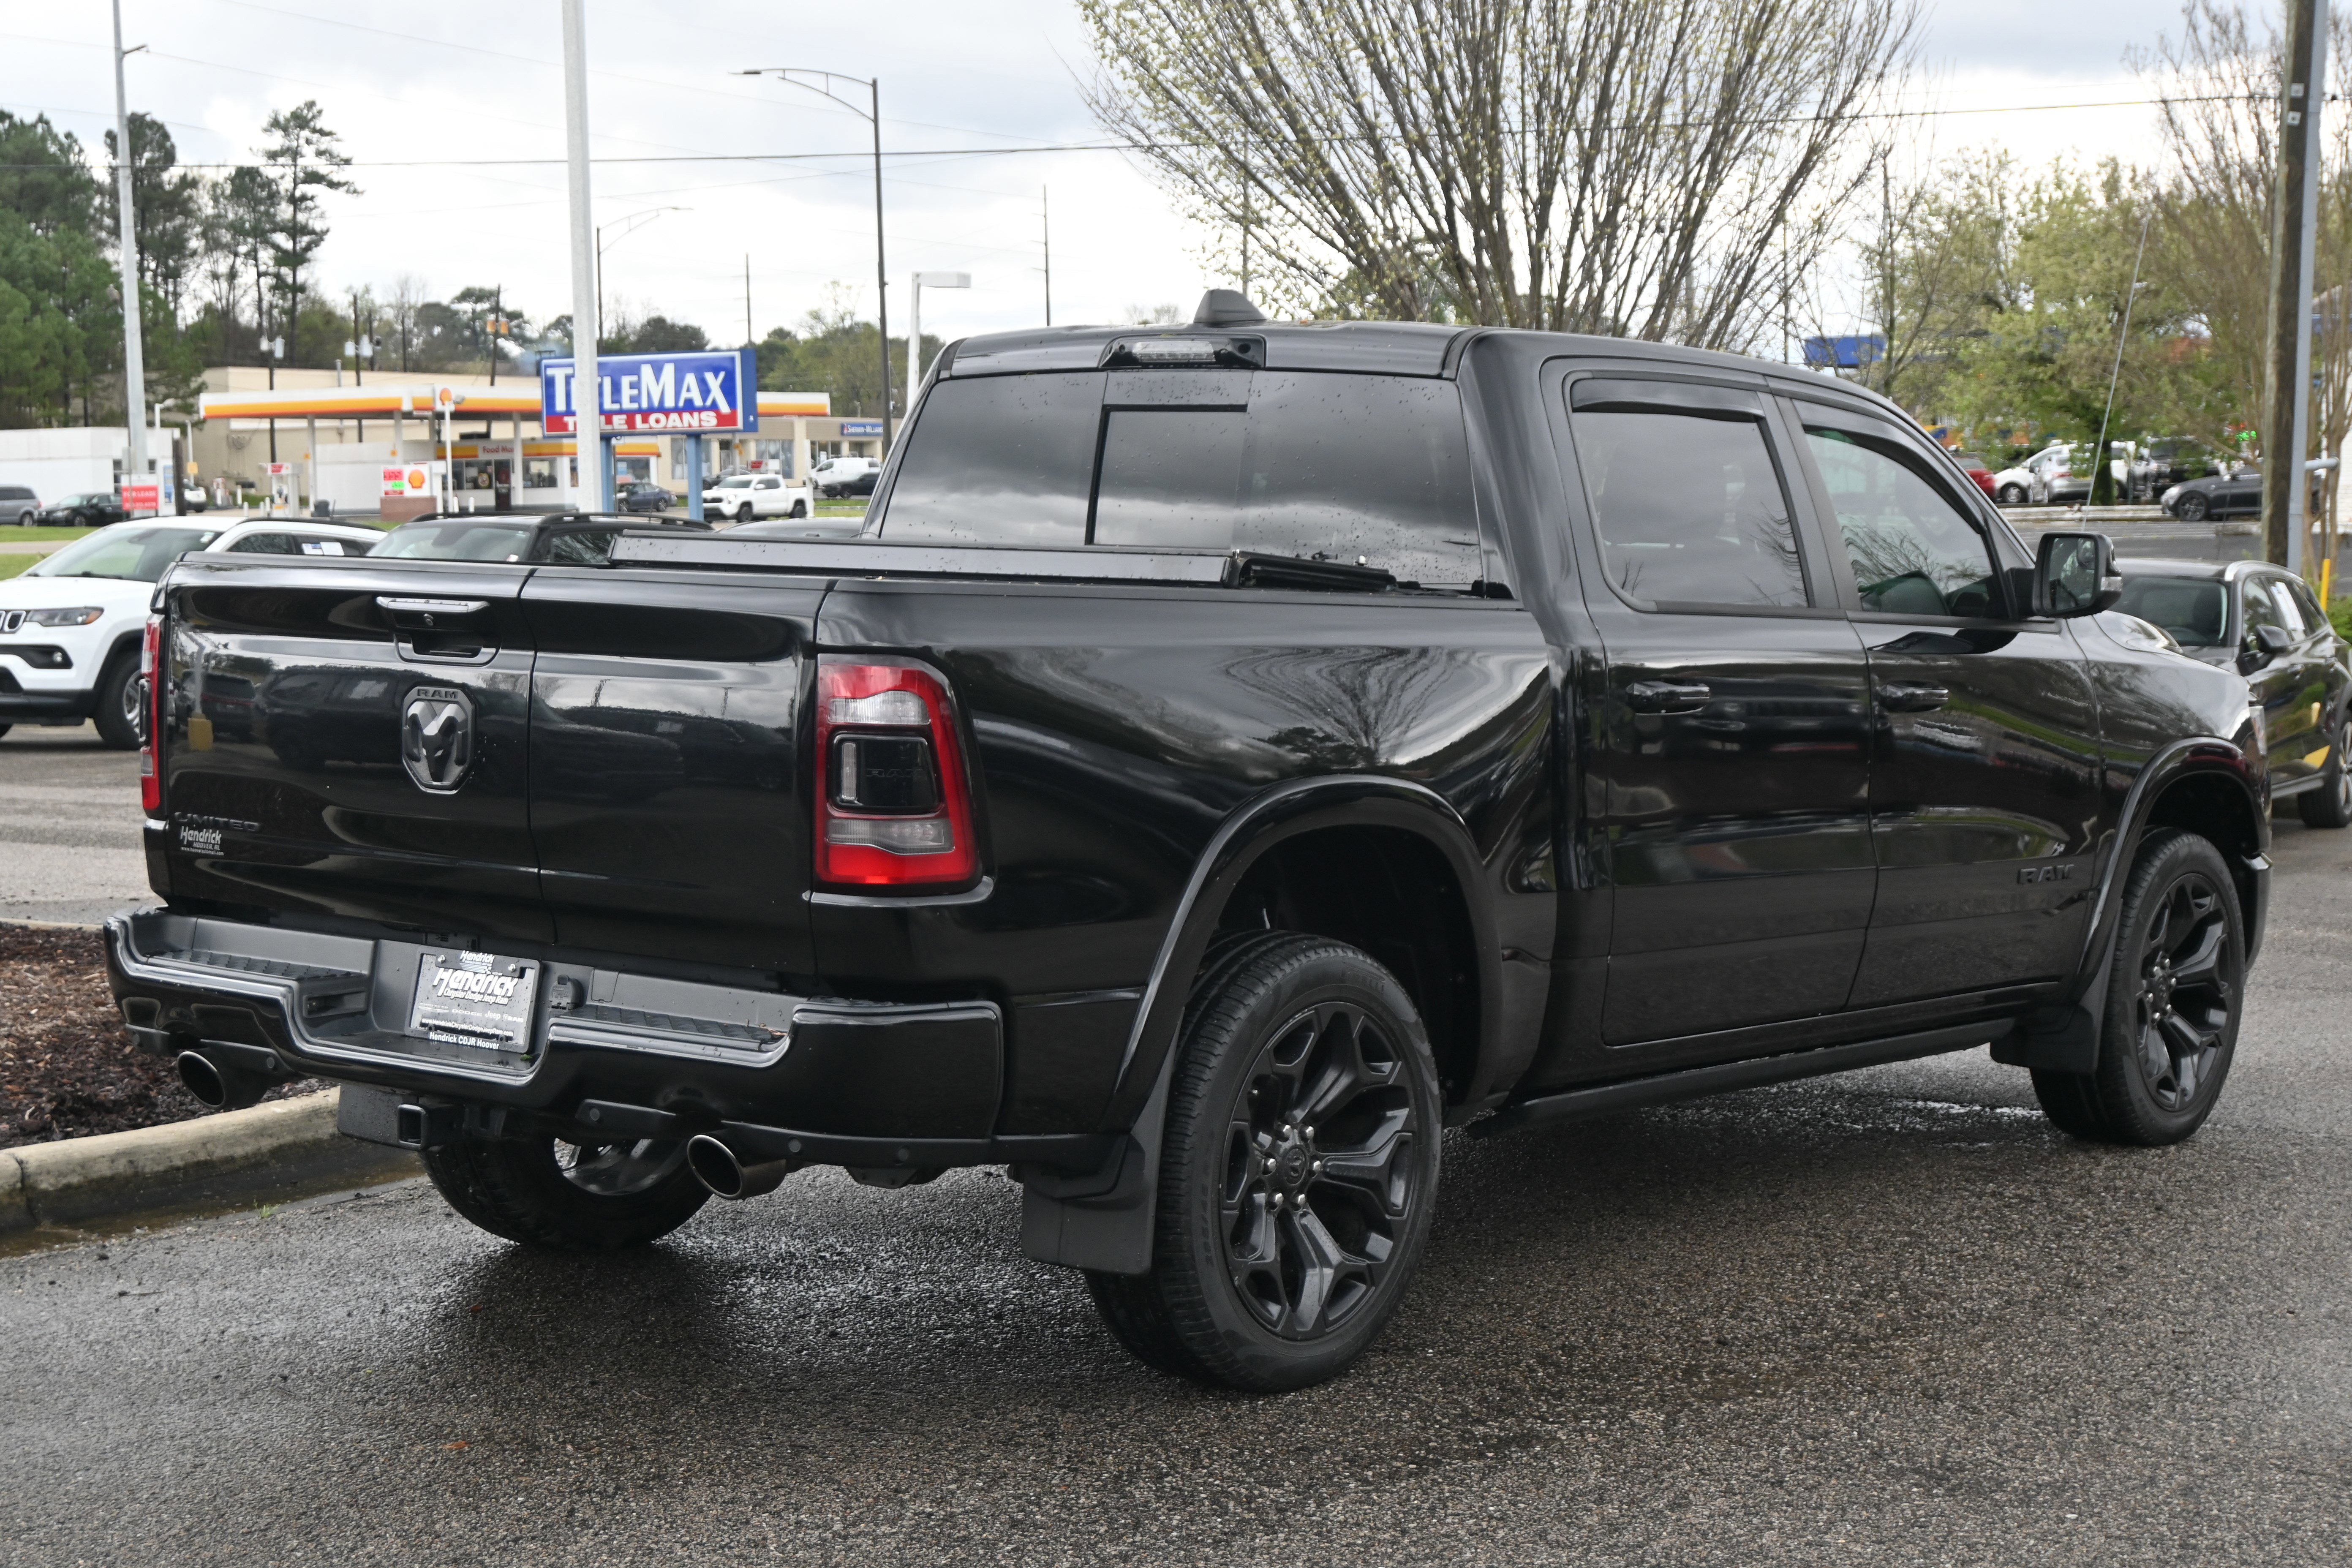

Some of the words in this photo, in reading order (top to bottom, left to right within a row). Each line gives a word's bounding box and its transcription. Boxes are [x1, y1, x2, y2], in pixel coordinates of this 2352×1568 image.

[564, 414, 628, 431] TLE
[636, 411, 717, 429] LOANS
[483, 445, 500, 453] Food
[417, 689, 459, 699] RAM
[866, 768, 925, 777] RAM
[174, 811, 260, 831] LIMITED
[180, 826, 222, 844] Hendrick
[193, 842, 213, 850] HOOVER,
[2017, 864, 2074, 884] RAM
[460, 950, 495, 963] Hendrick
[432, 967, 518, 997] Hendrick
[444, 988, 466, 999] Chrysler
[466, 991, 483, 1002] Dodge
[482, 994, 496, 1005] Jeep
[496, 996, 509, 1005] Ram
[452, 1009, 482, 1017] DODGE
[485, 1010, 501, 1020] Jeep
[422, 1018, 514, 1037] www.HendrickChryslerDodgeJeepRam.com
[429, 1032, 457, 1043] Hendrick
[458, 1037, 476, 1046] CDJR
[477, 1040, 500, 1050] Hoover
